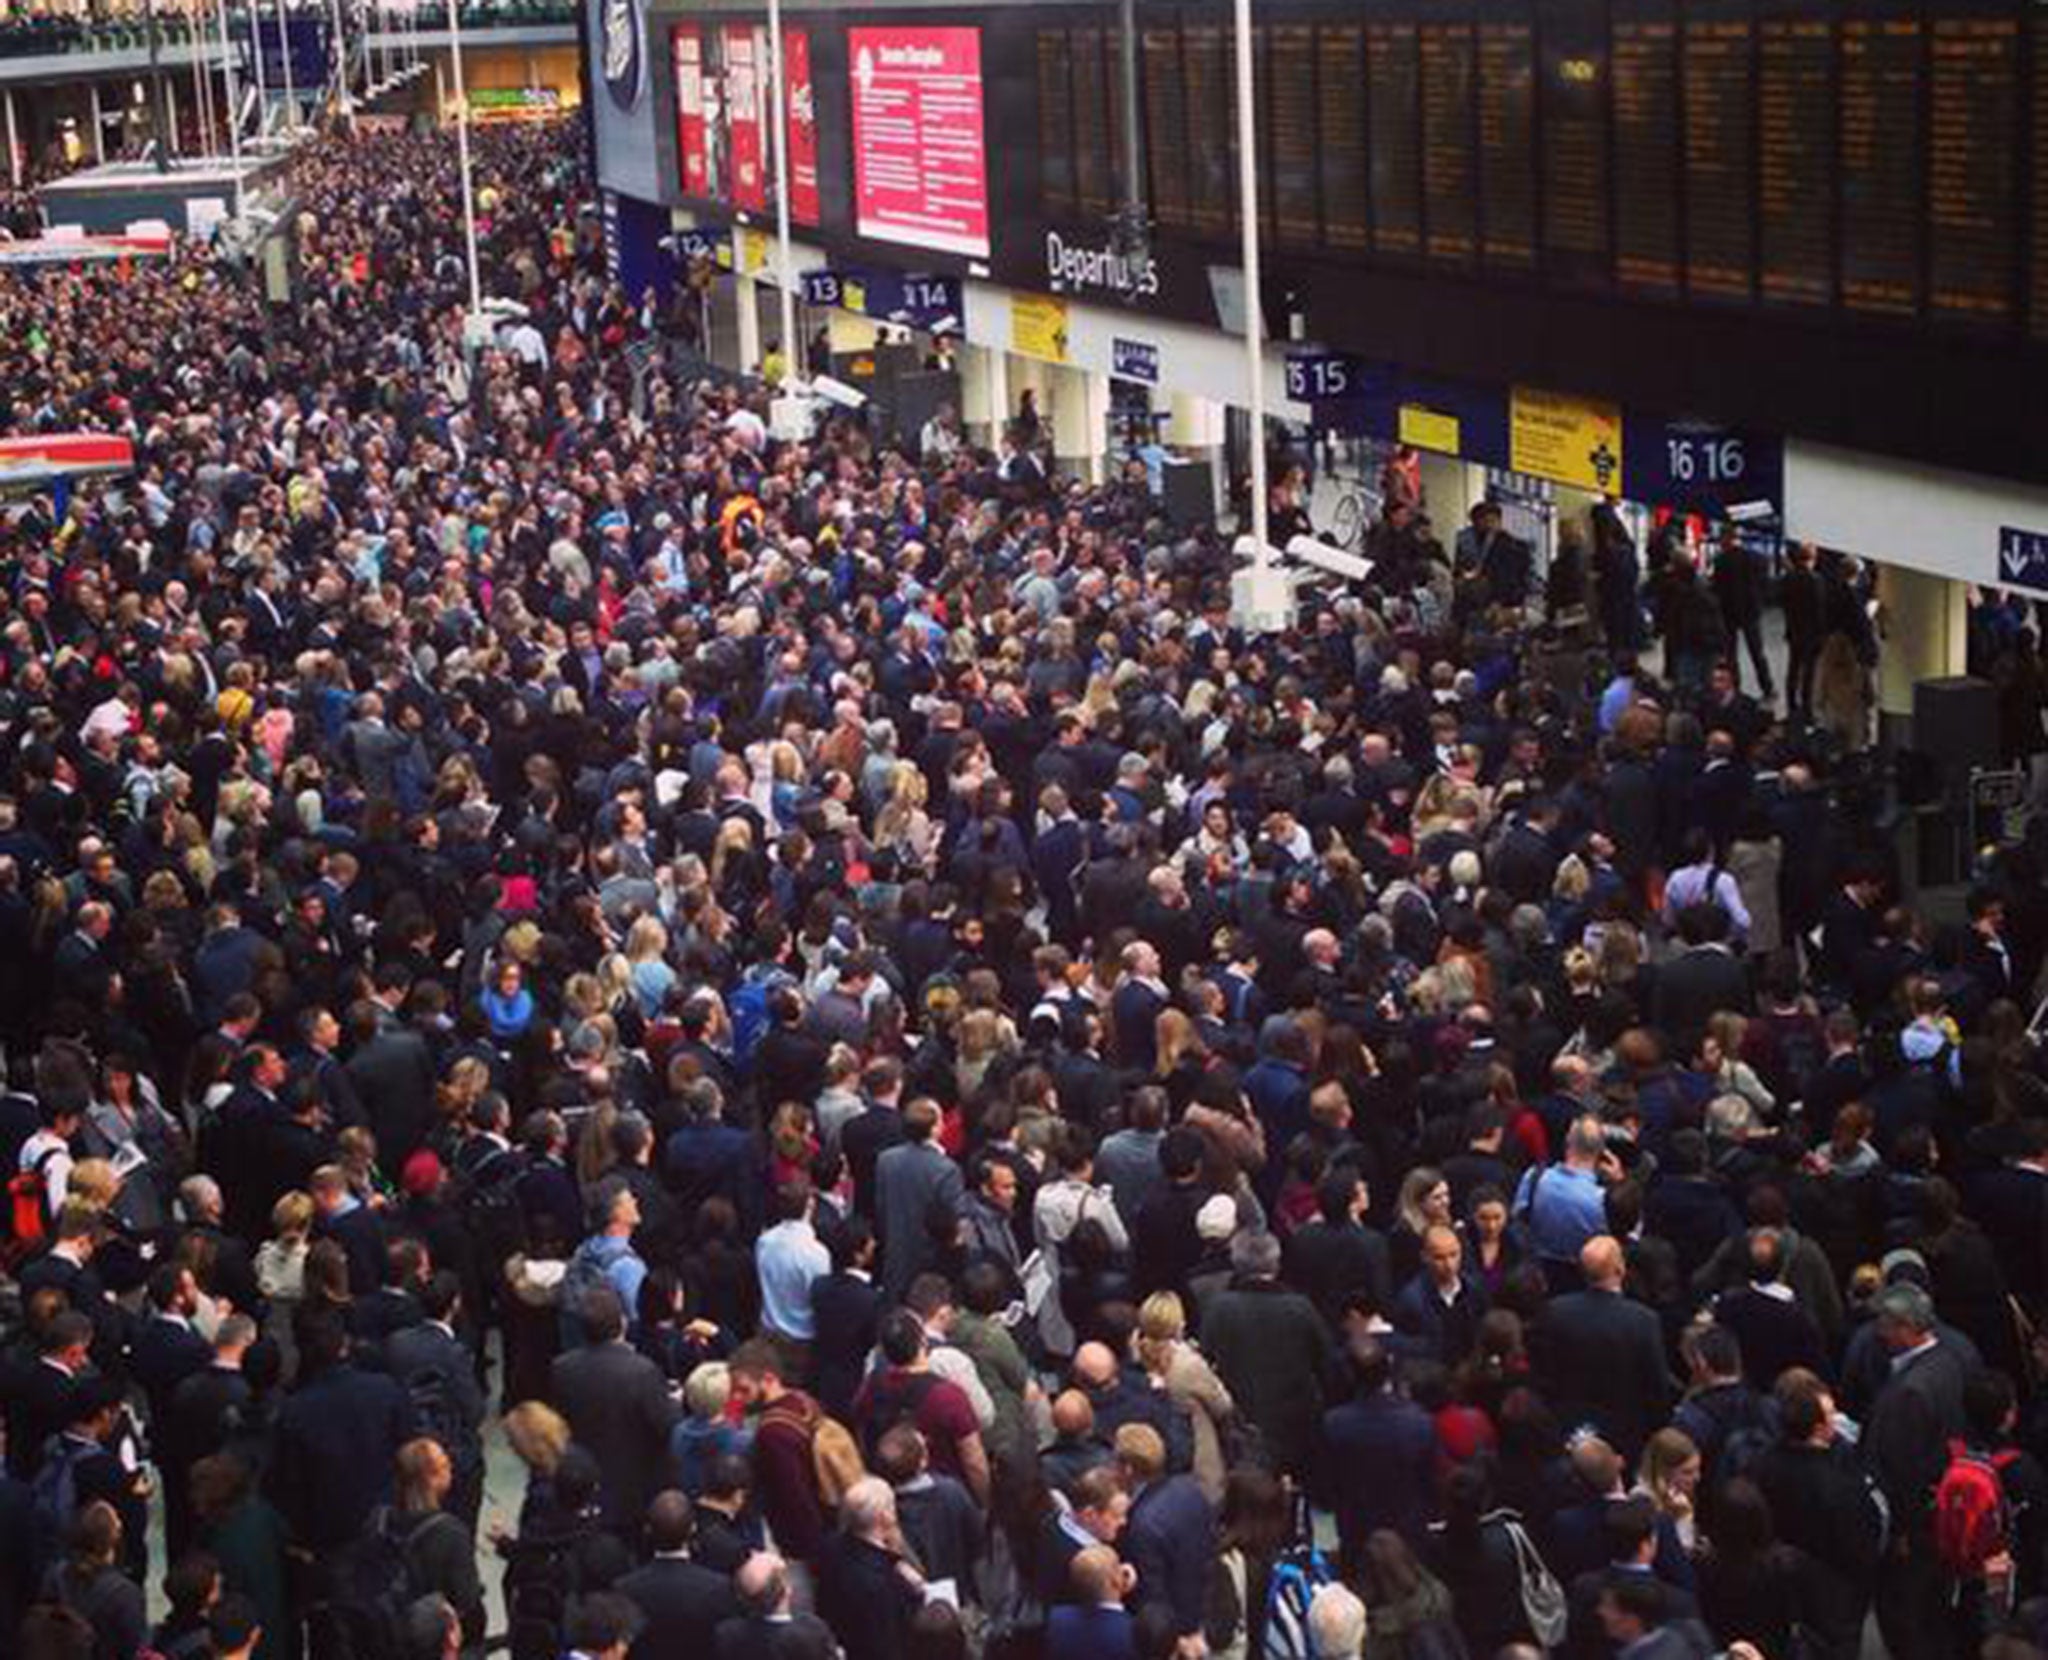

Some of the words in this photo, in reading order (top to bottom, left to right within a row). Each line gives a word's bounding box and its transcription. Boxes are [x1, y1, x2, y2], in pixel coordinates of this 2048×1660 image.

[1046, 231, 1159, 294] Departus
[812, 277, 838, 301] 13
[919, 283, 948, 308] 14
[1312, 361, 1347, 394] 15
[1667, 440, 1694, 480] 16
[1702, 440, 1745, 480] 16
